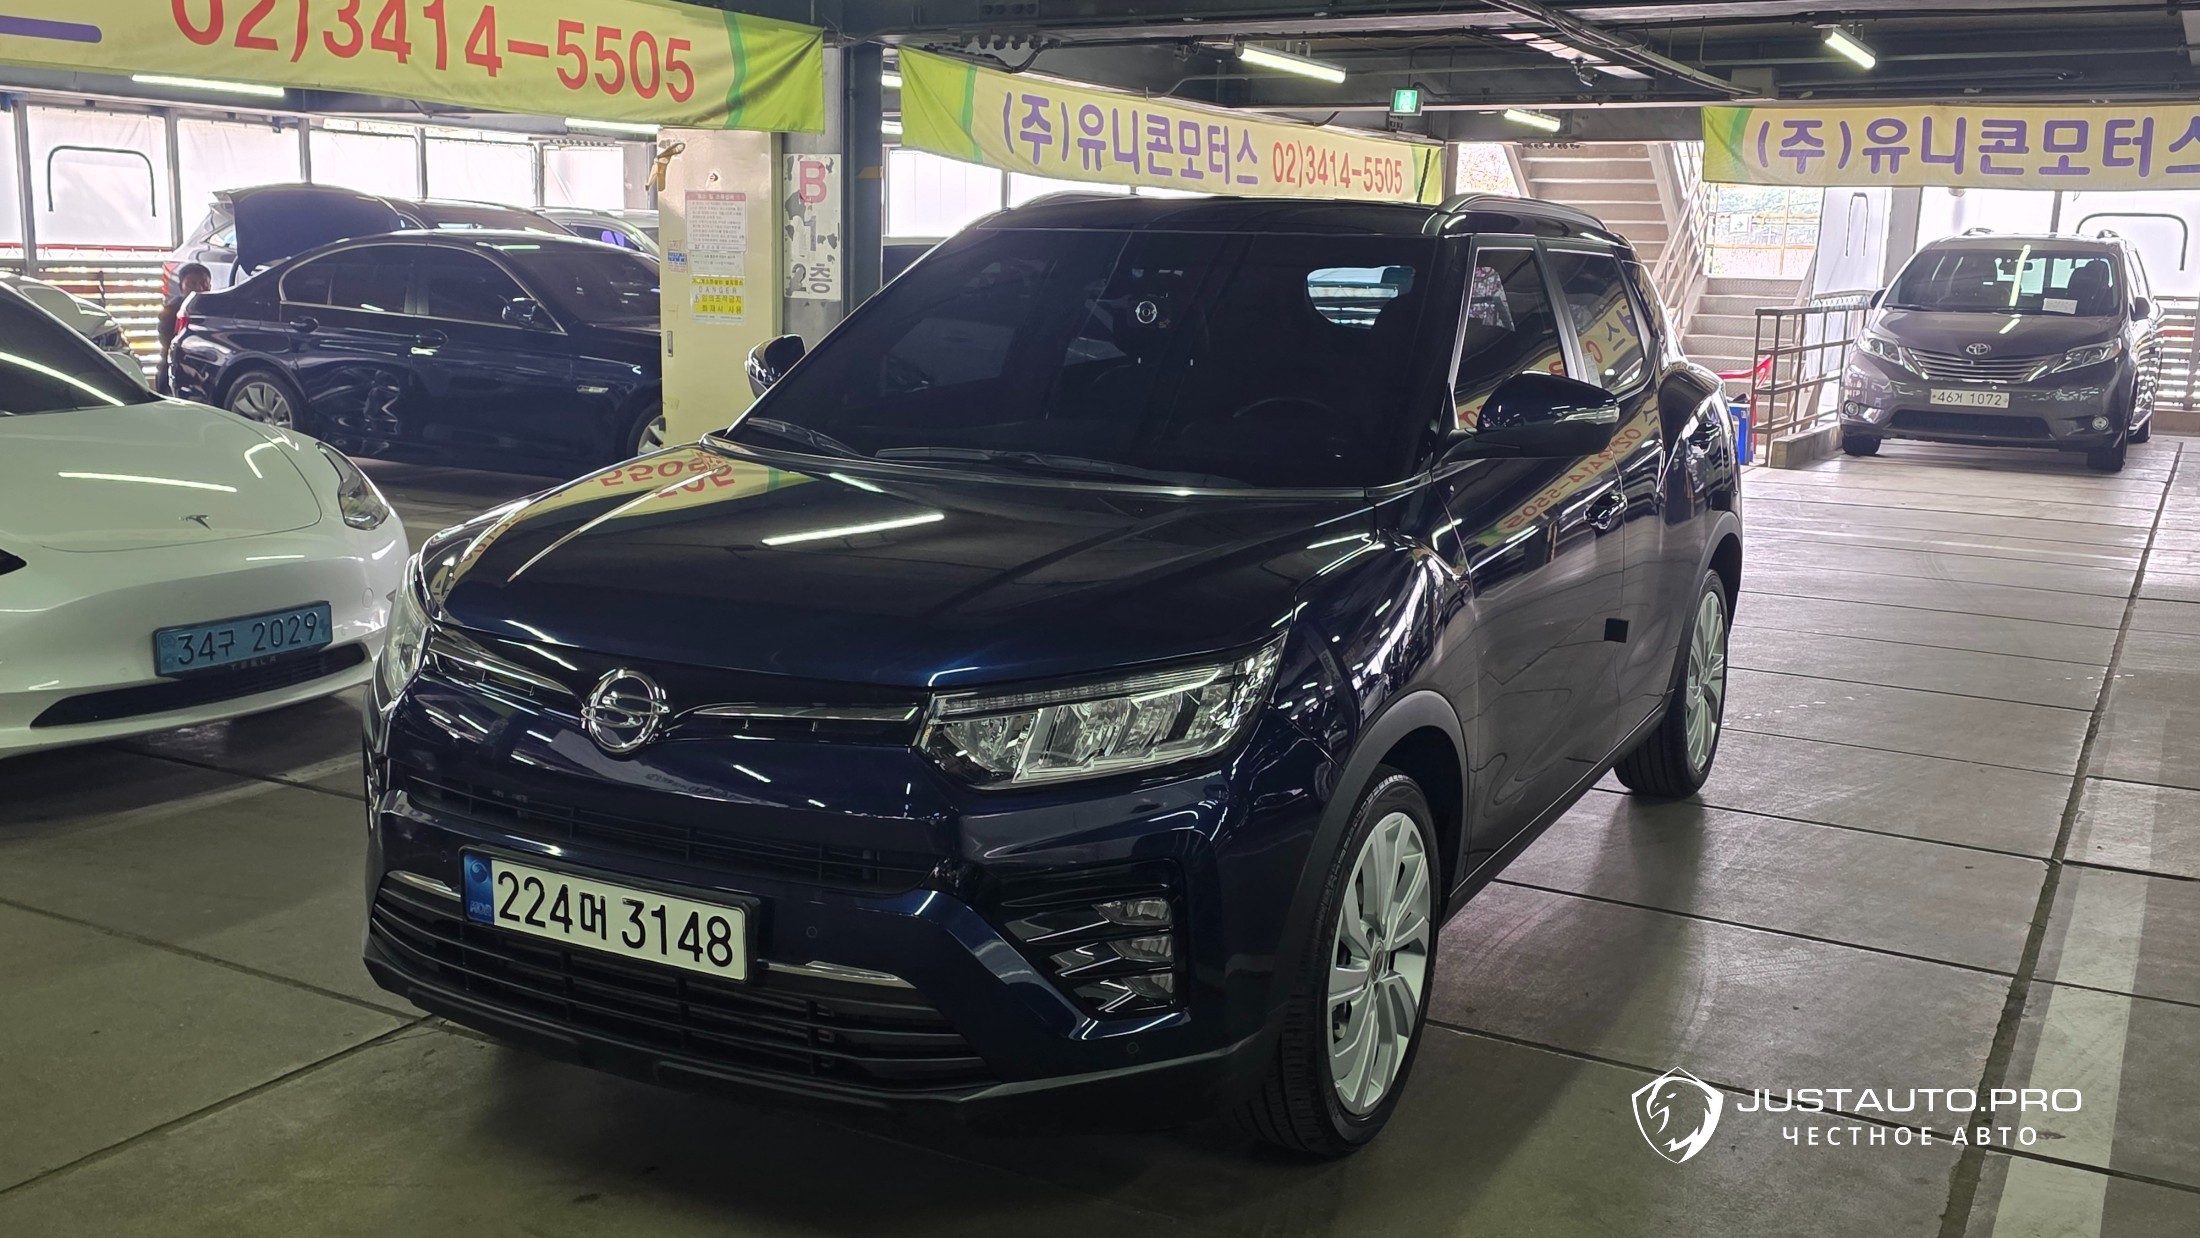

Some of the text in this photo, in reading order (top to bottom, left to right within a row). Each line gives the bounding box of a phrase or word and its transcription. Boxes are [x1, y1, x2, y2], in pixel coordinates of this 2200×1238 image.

[1003, 91, 1403, 195] (주)유니콘모터스 02)3414-5505
[799, 161, 827, 204] B
[698, 286, 737, 294] DANGER
[1970, 392, 2002, 406] 1072
[177, 611, 319, 665] 34구 2029
[498, 870, 734, 968] 224머 3148
